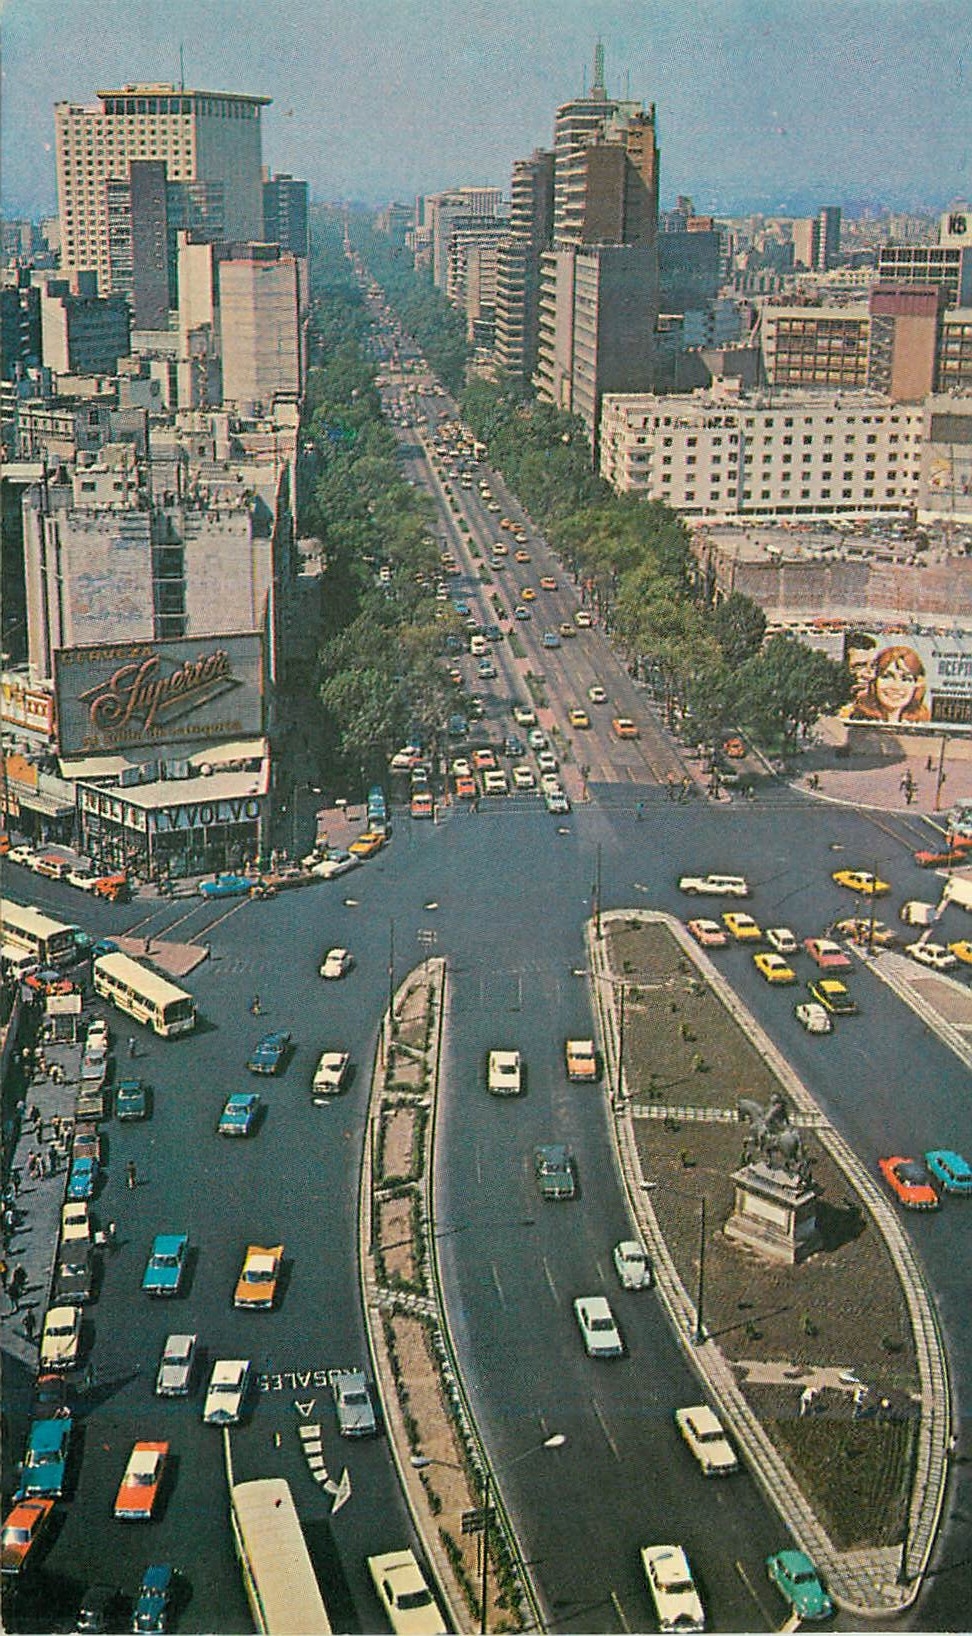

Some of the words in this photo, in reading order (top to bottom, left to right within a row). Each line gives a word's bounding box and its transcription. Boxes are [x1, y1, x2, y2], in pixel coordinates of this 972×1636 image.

[78, 649, 230, 731] Superior
[186, 799, 261, 827] VOLVO
[257, 1367, 357, 1392] OSALES
[294, 1399, 317, 1417] A
